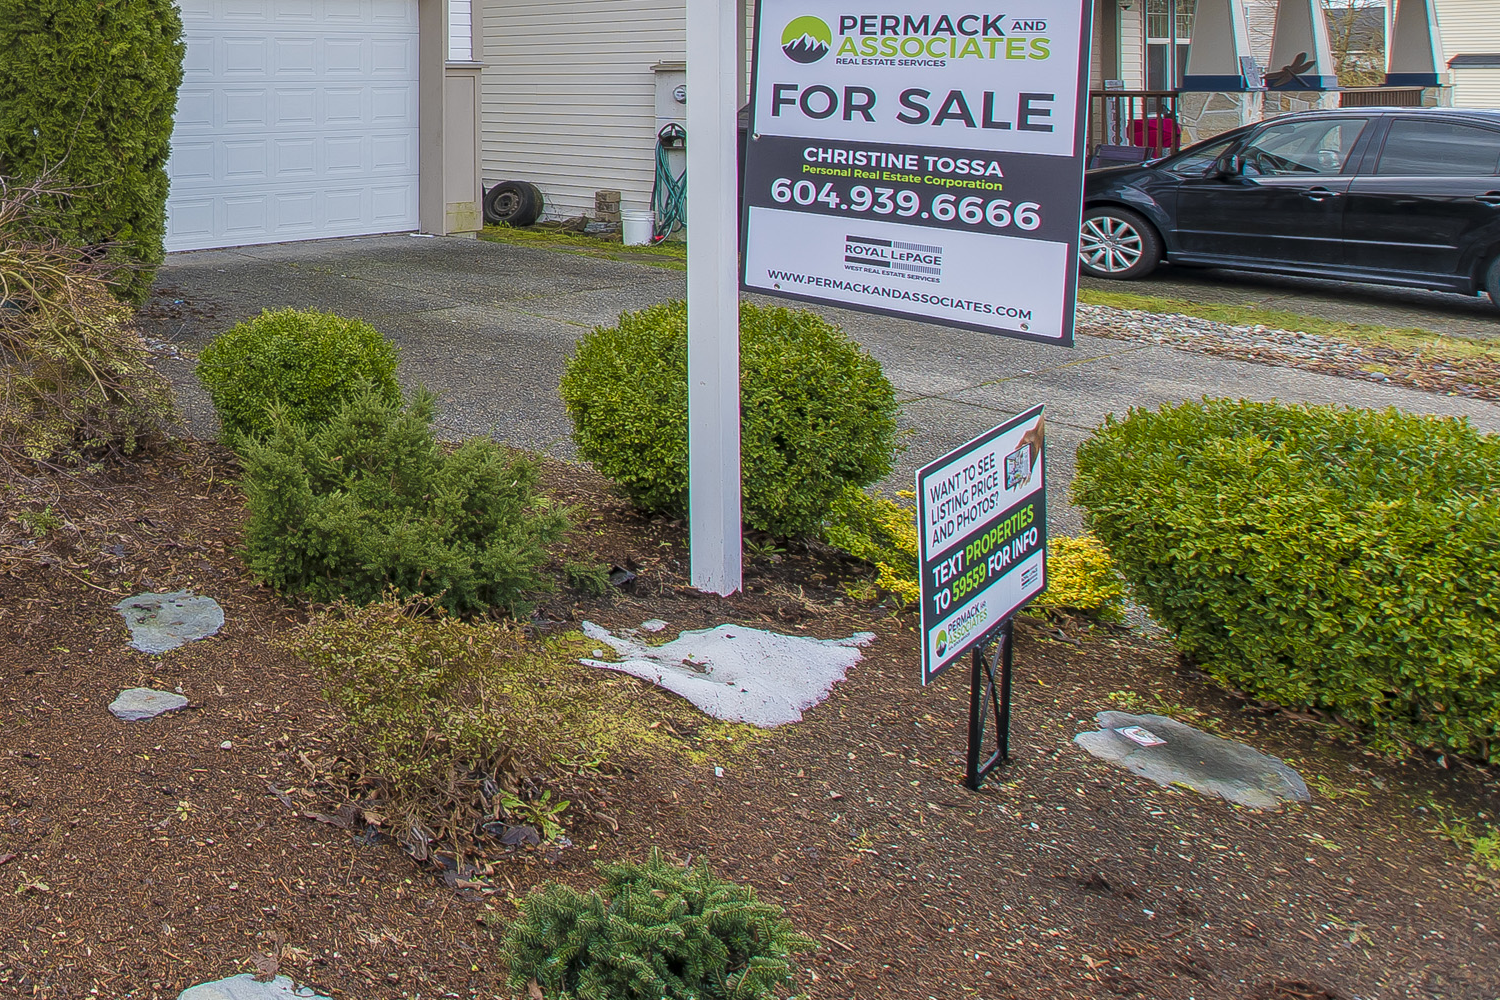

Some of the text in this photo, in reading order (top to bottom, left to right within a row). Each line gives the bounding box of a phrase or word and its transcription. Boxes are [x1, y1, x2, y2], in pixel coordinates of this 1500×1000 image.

[839, 14, 1047, 36] PERMACK AND
[836, 36, 1051, 60] ASSOCIATES
[861, 58, 896, 66] ESTATE
[898, 59, 946, 67] SERVICES
[771, 83, 1055, 133] FOR SALE
[802, 164, 1003, 191] Personal Real Estate Corporation
[803, 147, 1004, 178] CHRISTINE TOSSA
[771, 178, 1041, 231] 604.939.6666
[844, 244, 888, 258] ROYAL
[863, 267, 881, 275] REAL
[881, 270, 906, 278] ESTATE
[906, 273, 941, 283] SERVICES
[767, 269, 1032, 321] WWW.PERMACKANDASSOCIATES.COM
[930, 452, 995, 503] WANT TO SEE
[931, 471, 998, 525] LISTING PRICE
[931, 490, 999, 547] AND PHOTOS?
[932, 504, 1034, 588] TEXT PROPERTIES
[933, 588, 951, 615] TO
[952, 562, 986, 602] 59559
[988, 545, 1012, 577] FOR
[1012, 527, 1038, 559] INFO
[947, 602, 980, 635] PERMACK
[948, 608, 988, 645] ASSOCIATES
